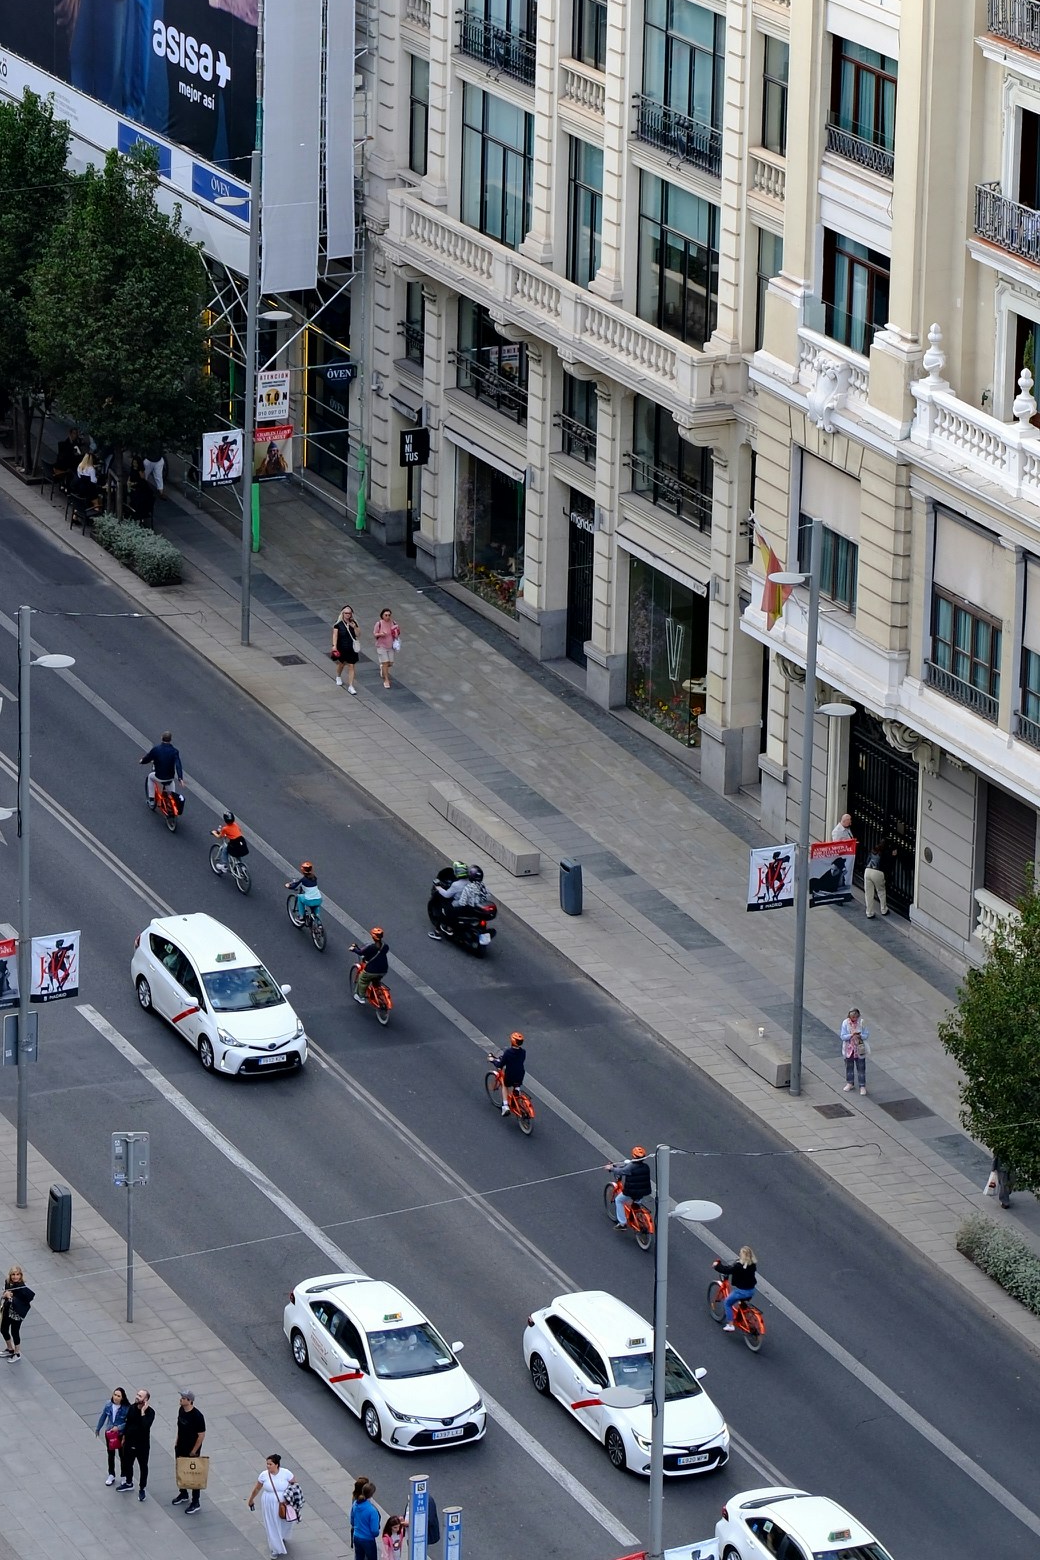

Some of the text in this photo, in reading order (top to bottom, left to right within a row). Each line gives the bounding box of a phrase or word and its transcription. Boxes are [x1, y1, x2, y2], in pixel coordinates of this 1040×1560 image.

[178, 80, 215, 110] mejor así
[259, 390, 288, 403] ATÓN
[405, 452, 419, 462] TUS
[928, 799, 933, 811] 2
